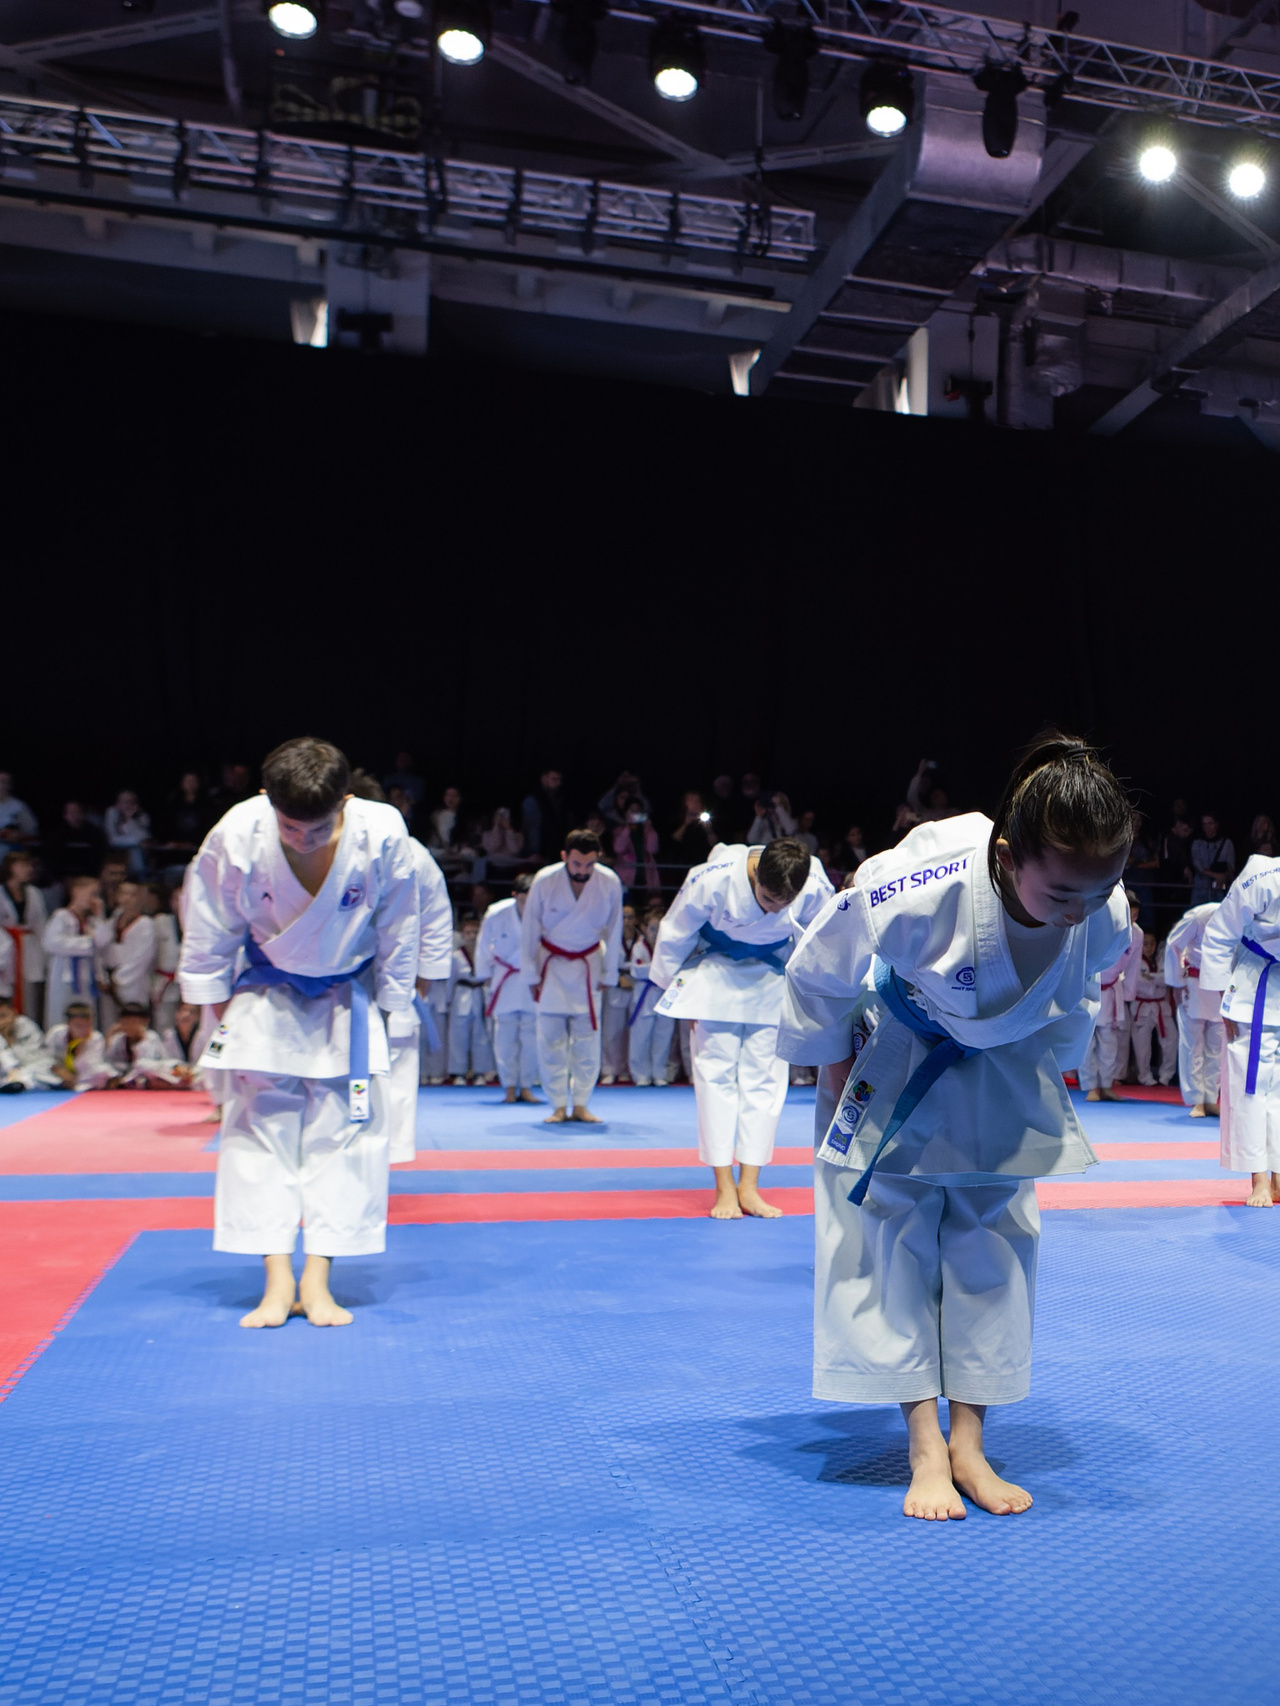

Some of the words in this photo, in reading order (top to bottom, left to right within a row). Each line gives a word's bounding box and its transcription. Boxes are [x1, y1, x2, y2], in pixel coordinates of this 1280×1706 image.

[869, 876, 907, 909] BEST
[910, 856, 970, 889] SPORT
[1241, 874, 1258, 890] BEST
